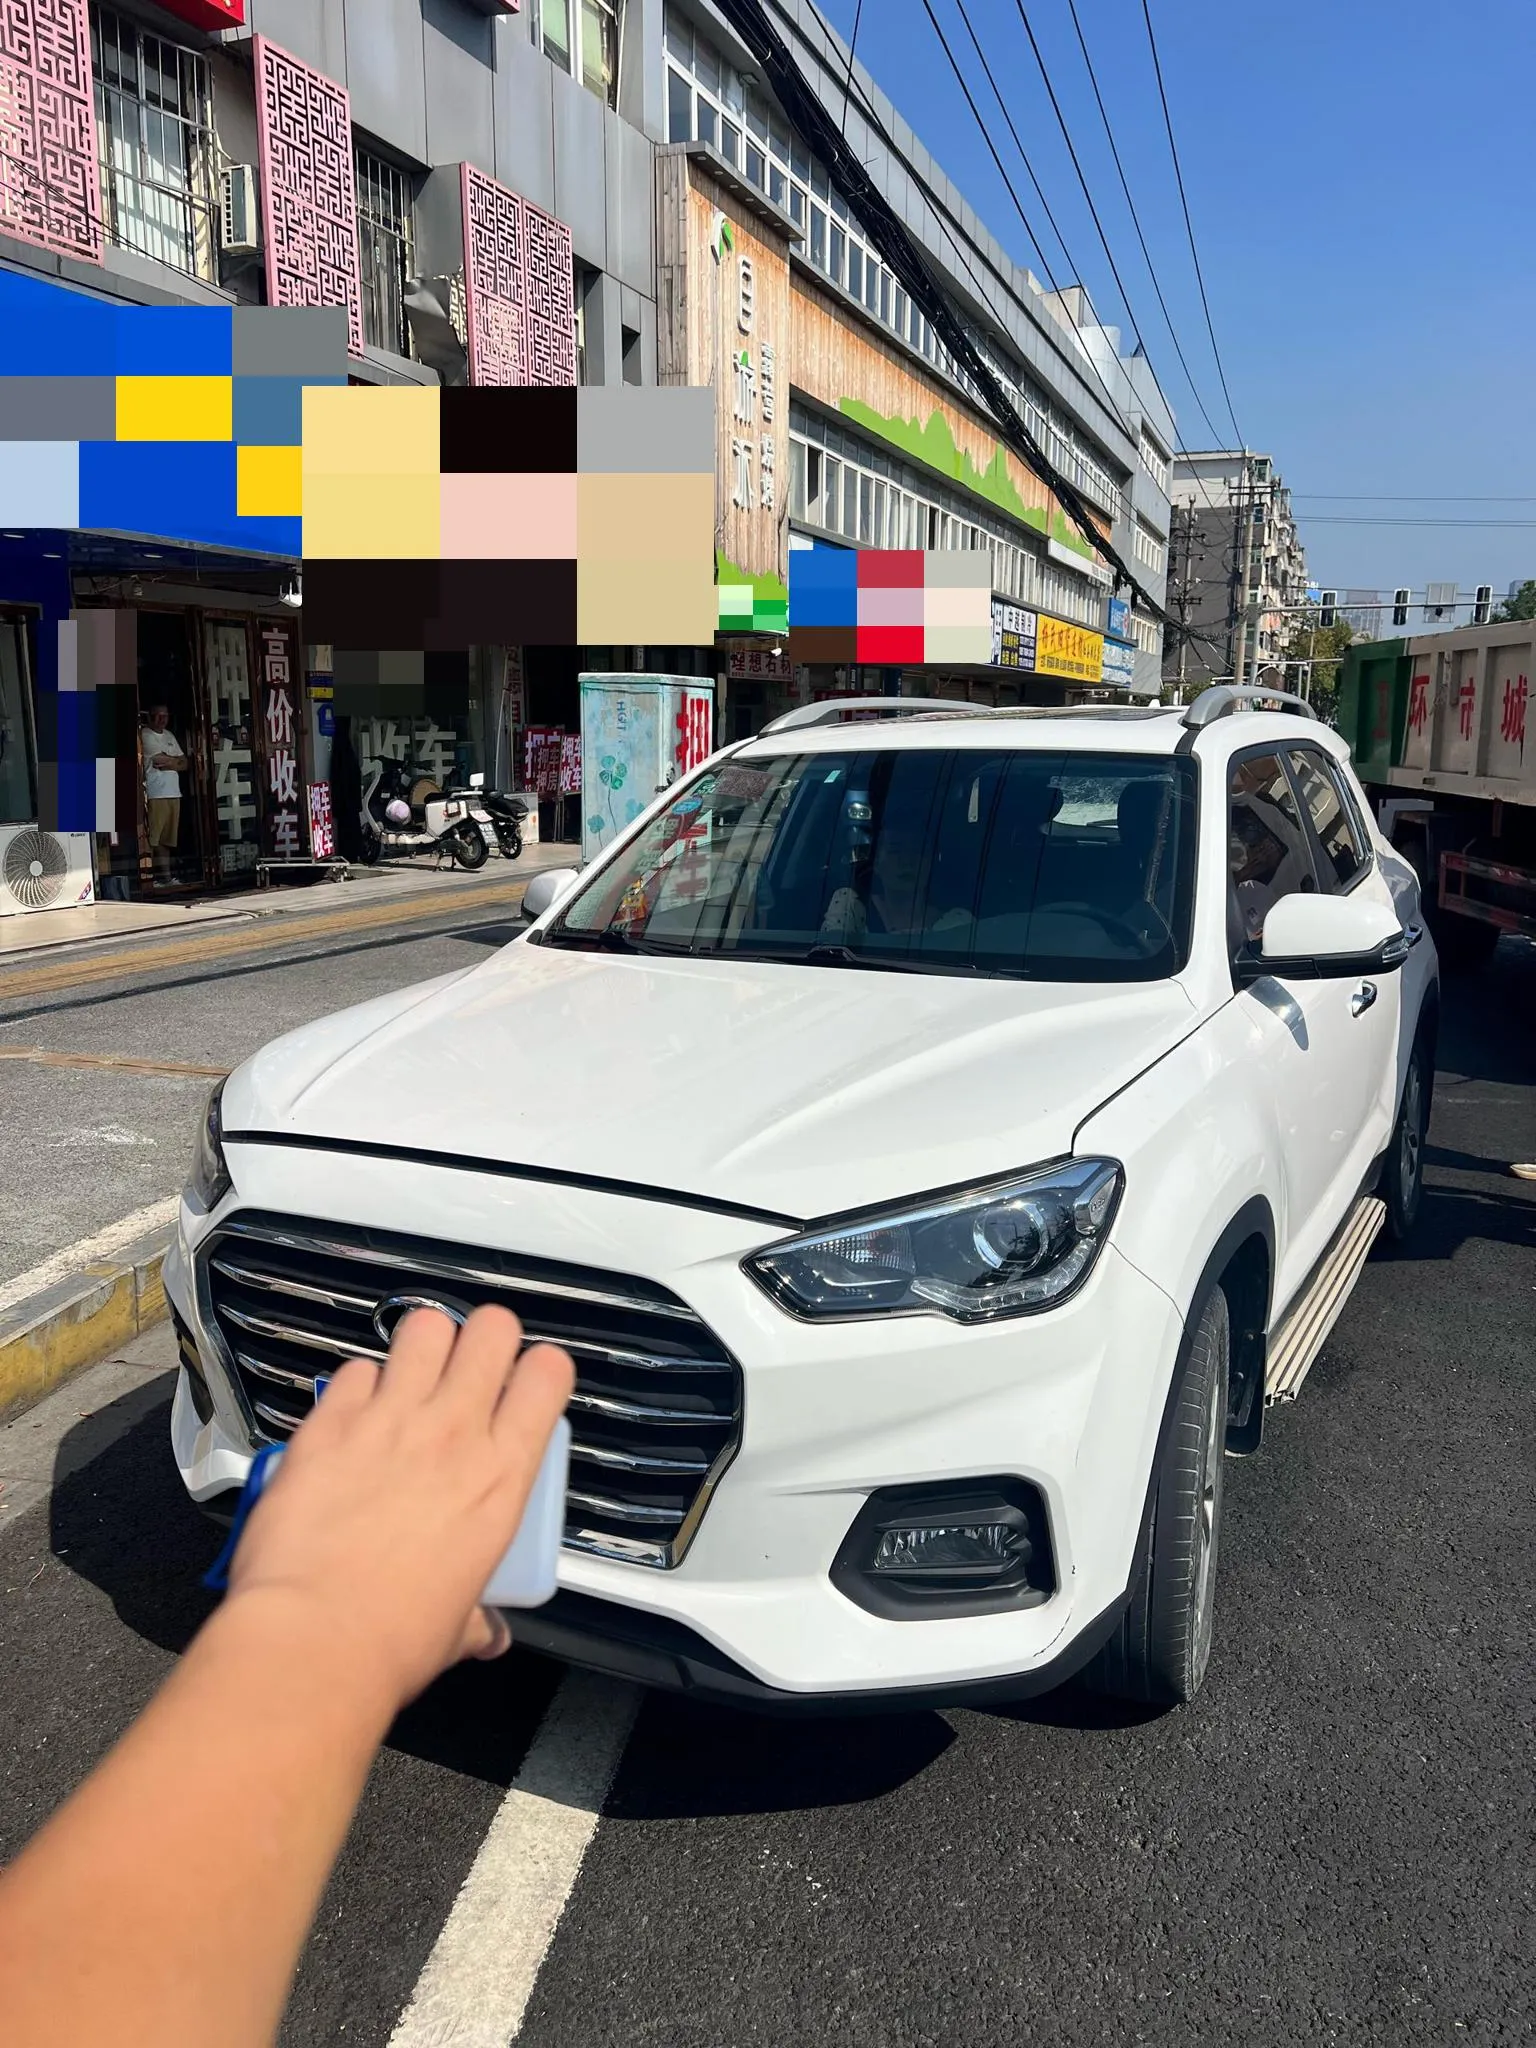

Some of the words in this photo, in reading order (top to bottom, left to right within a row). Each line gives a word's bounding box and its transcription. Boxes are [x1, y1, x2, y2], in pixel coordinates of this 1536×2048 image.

[262, 627, 299, 858] 高价收车
[361, 720, 456, 791] 收车
[313, 821, 333, 858] 收车
